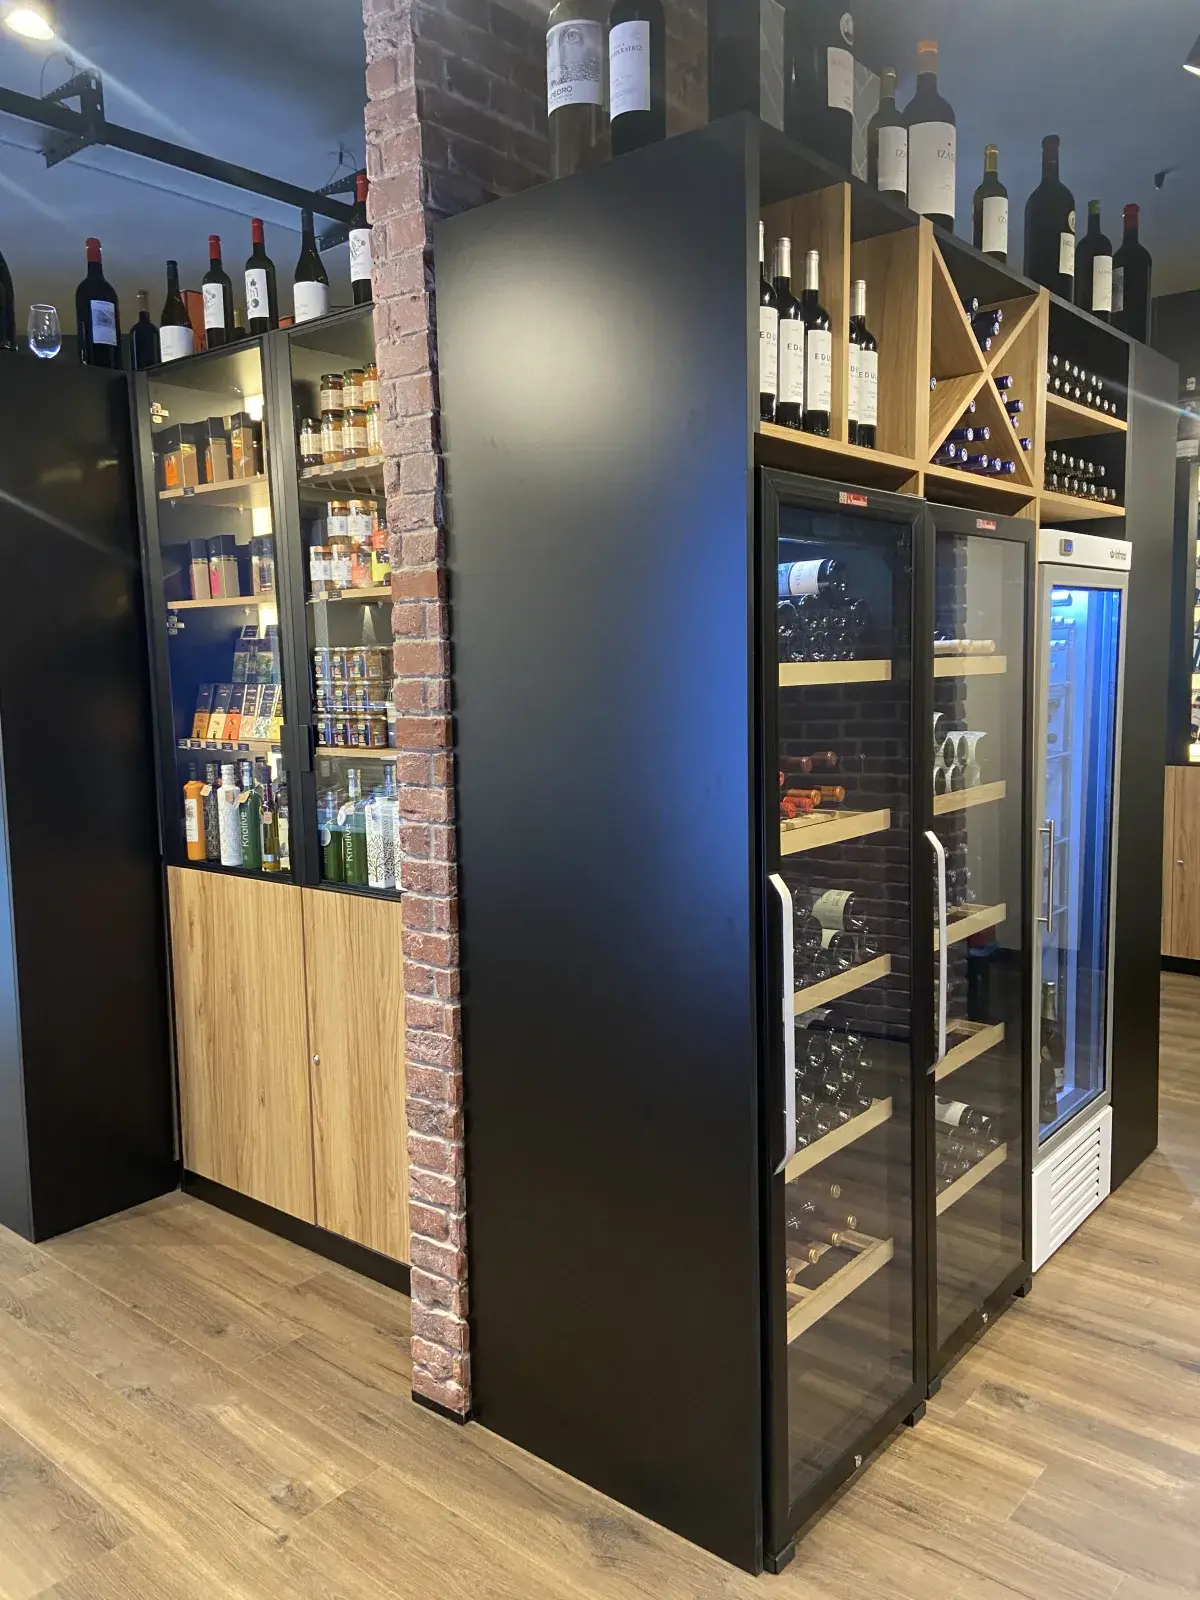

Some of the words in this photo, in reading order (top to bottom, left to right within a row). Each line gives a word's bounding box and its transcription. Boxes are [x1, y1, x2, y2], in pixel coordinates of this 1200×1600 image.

[551, 86, 573, 98] PEDRO
[240, 811, 249, 847] Knolive
[344, 823, 354, 862] Knolive
